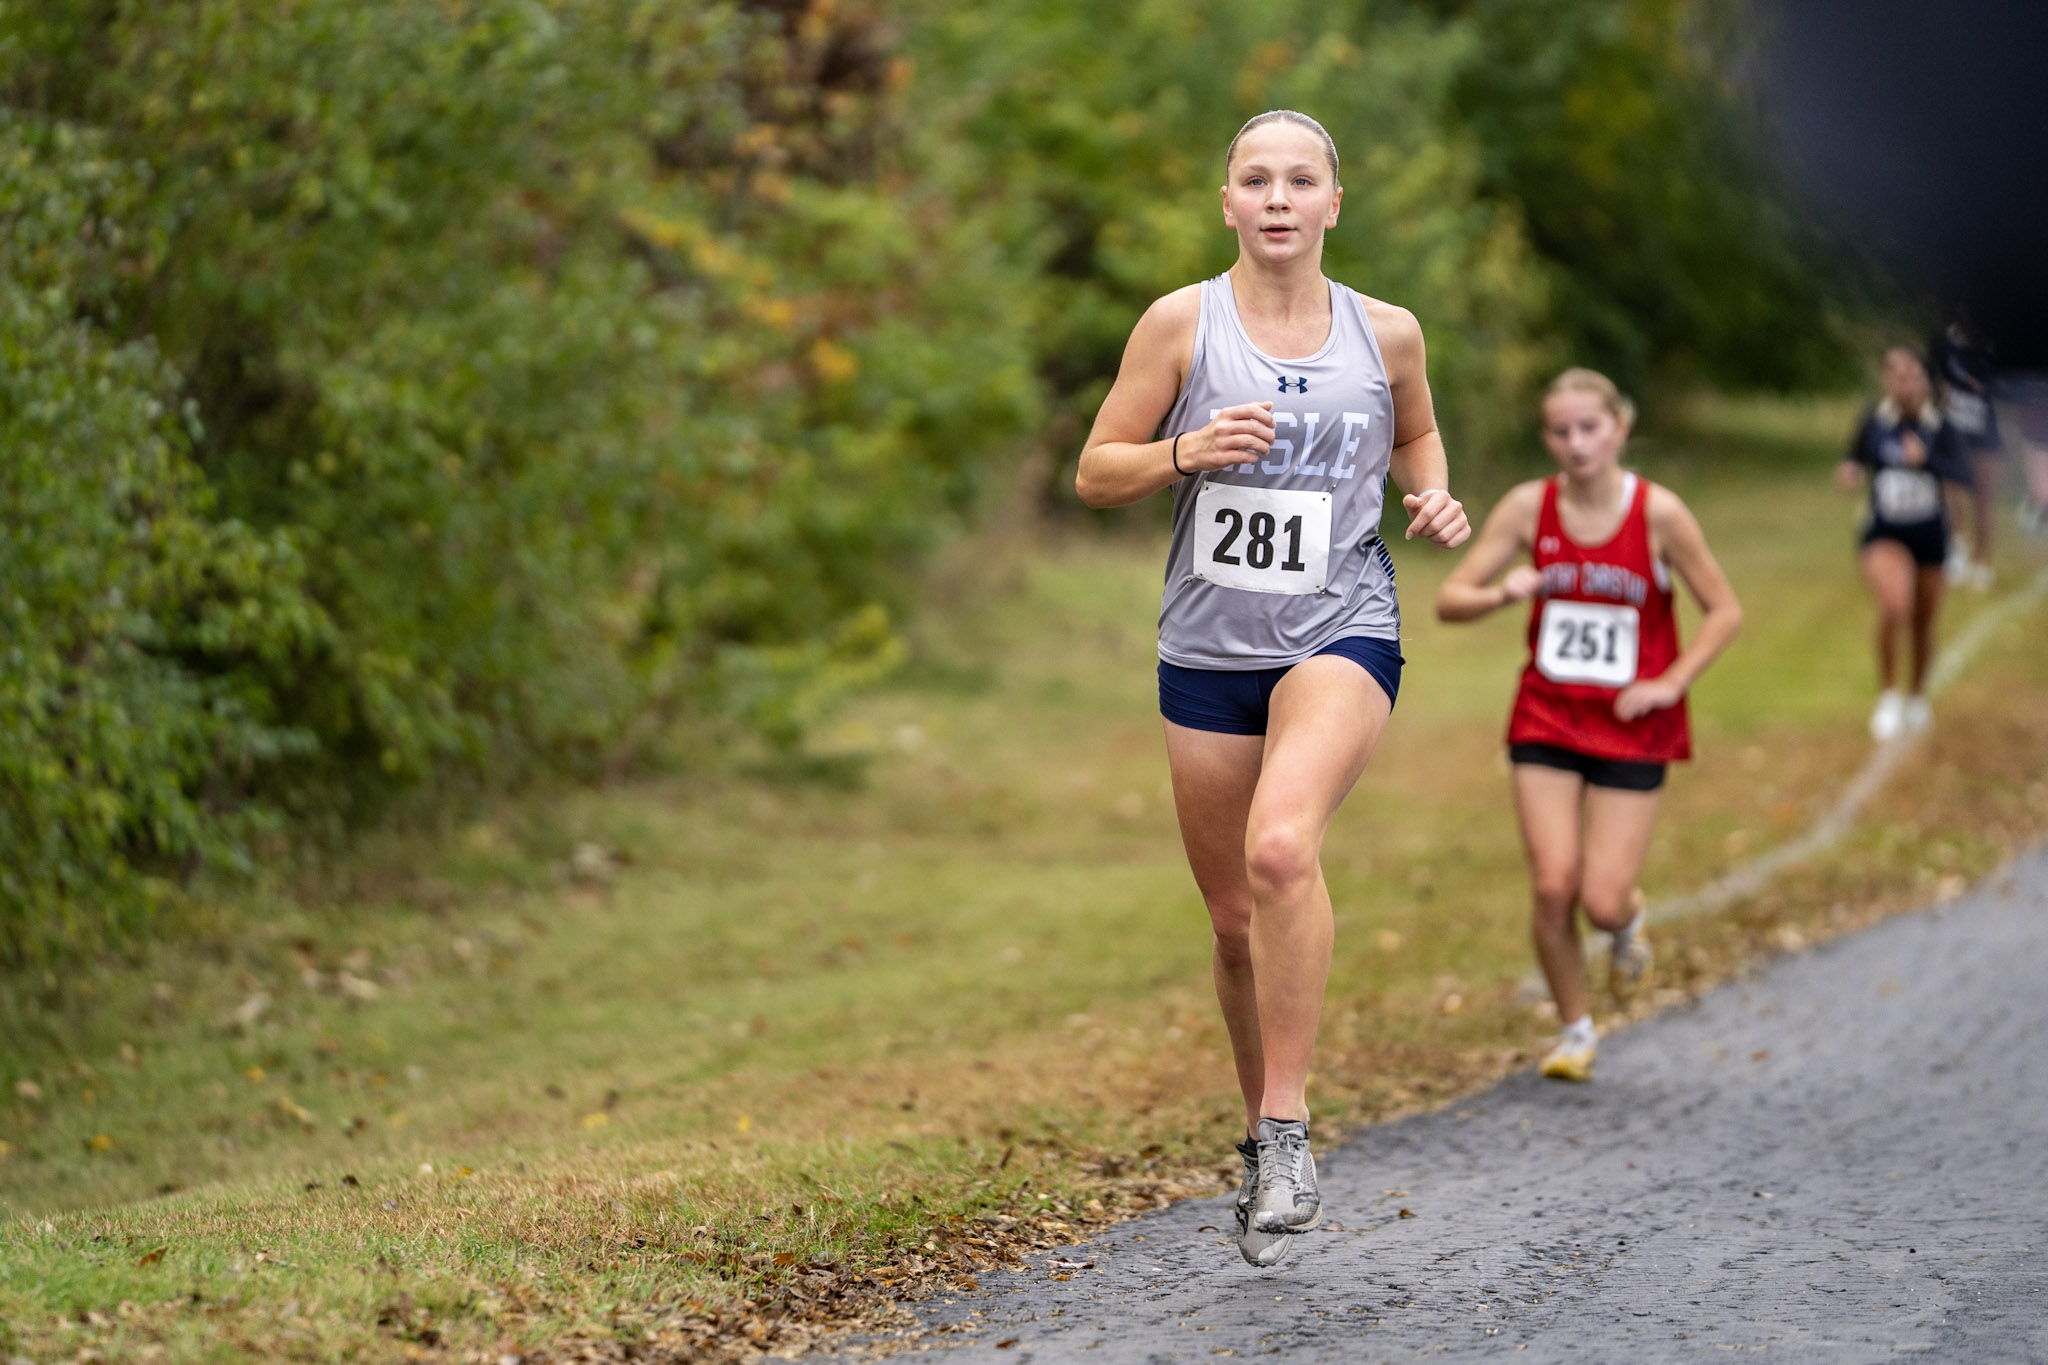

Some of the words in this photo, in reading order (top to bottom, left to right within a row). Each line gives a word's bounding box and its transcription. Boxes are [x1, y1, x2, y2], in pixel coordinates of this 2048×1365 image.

[1210, 408, 1370, 480] SLE
[1212, 508, 1306, 572] 281
[1556, 619, 1617, 664] 251
